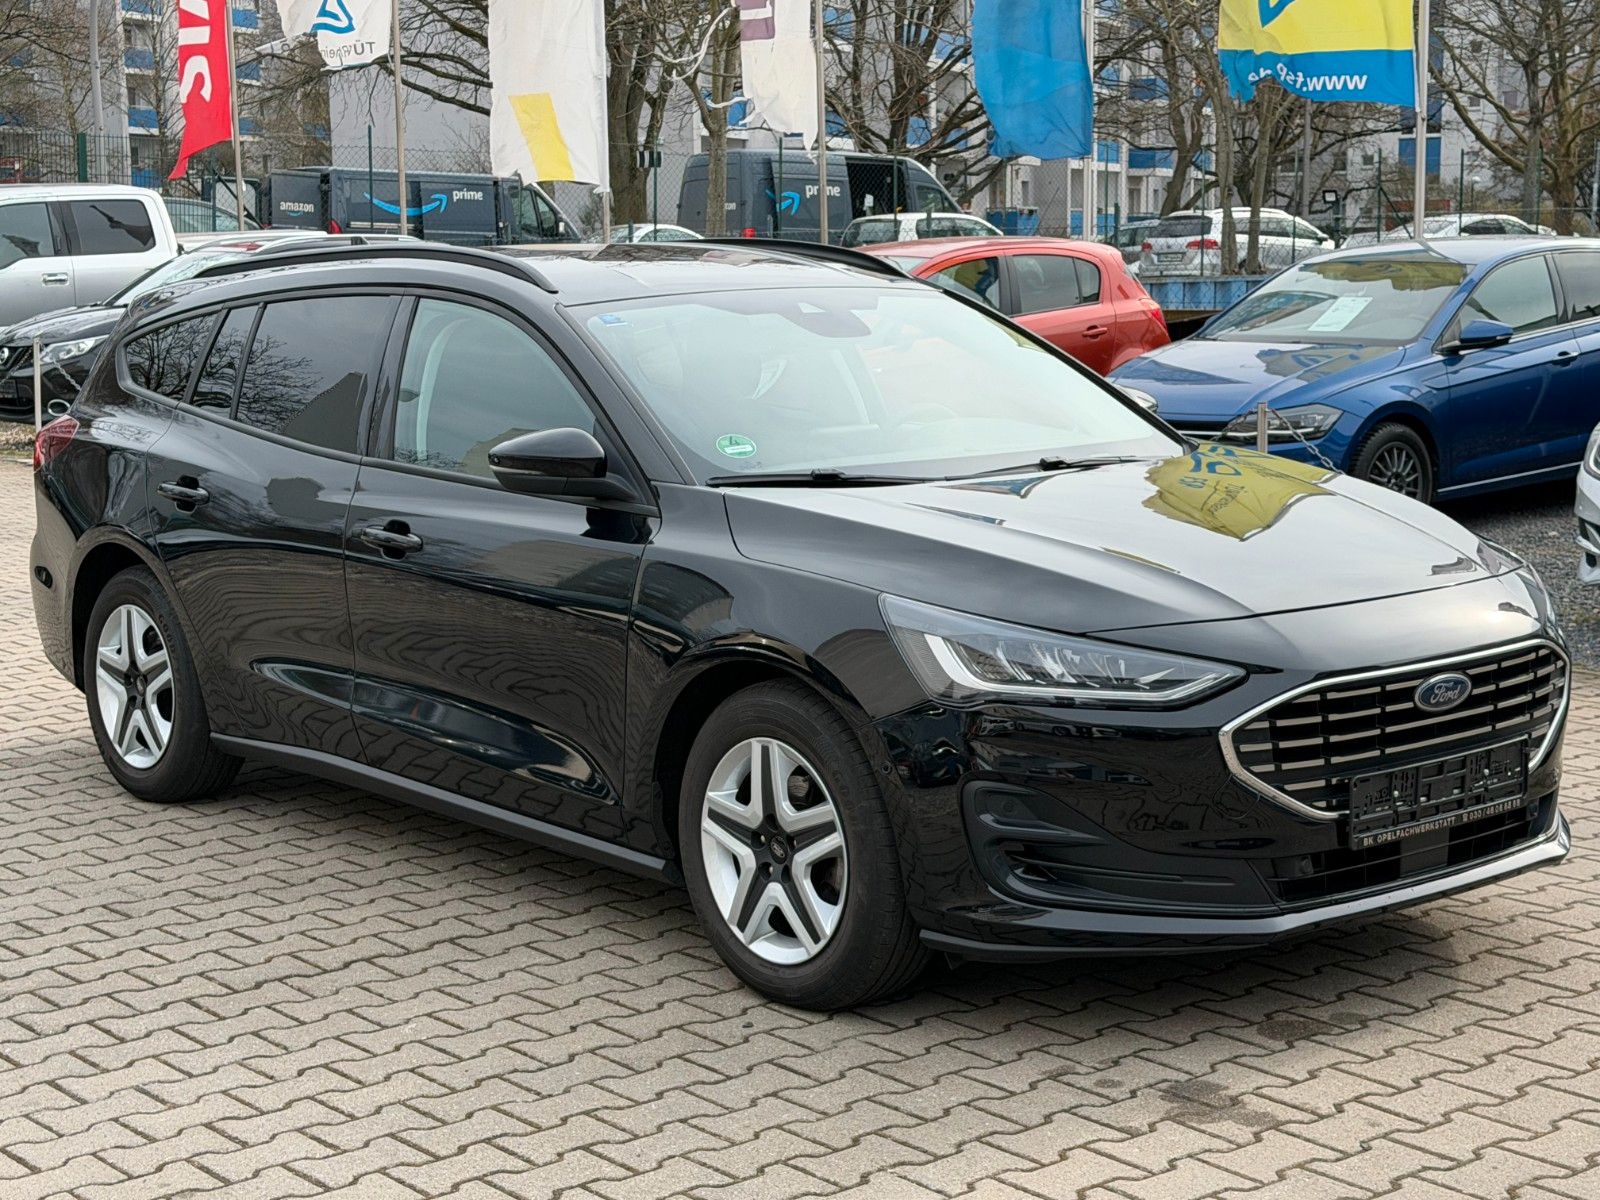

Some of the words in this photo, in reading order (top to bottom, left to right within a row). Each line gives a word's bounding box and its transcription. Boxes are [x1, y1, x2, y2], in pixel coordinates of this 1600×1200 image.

[452, 187, 483, 203] prime
[279, 201, 315, 213] amazon
[1430, 681, 1461, 704] Ford
